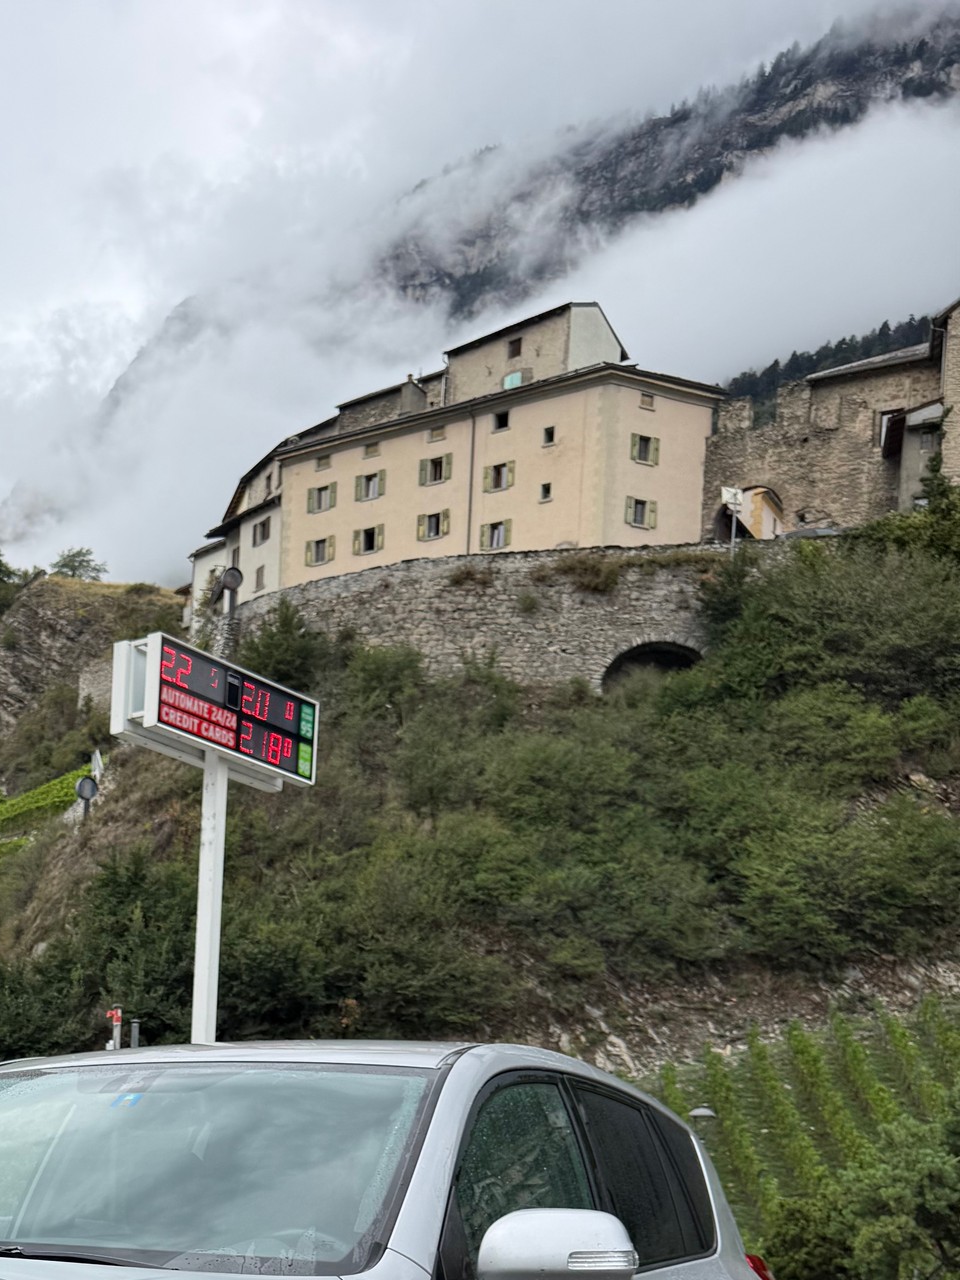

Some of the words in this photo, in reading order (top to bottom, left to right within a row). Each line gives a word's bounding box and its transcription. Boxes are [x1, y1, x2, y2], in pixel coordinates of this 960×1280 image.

[161, 686, 209, 719] AUTOMATE
[211, 706, 237, 730] 24/24
[161, 707, 199, 732] CREDIT
[201, 720, 235, 747] CARDS
